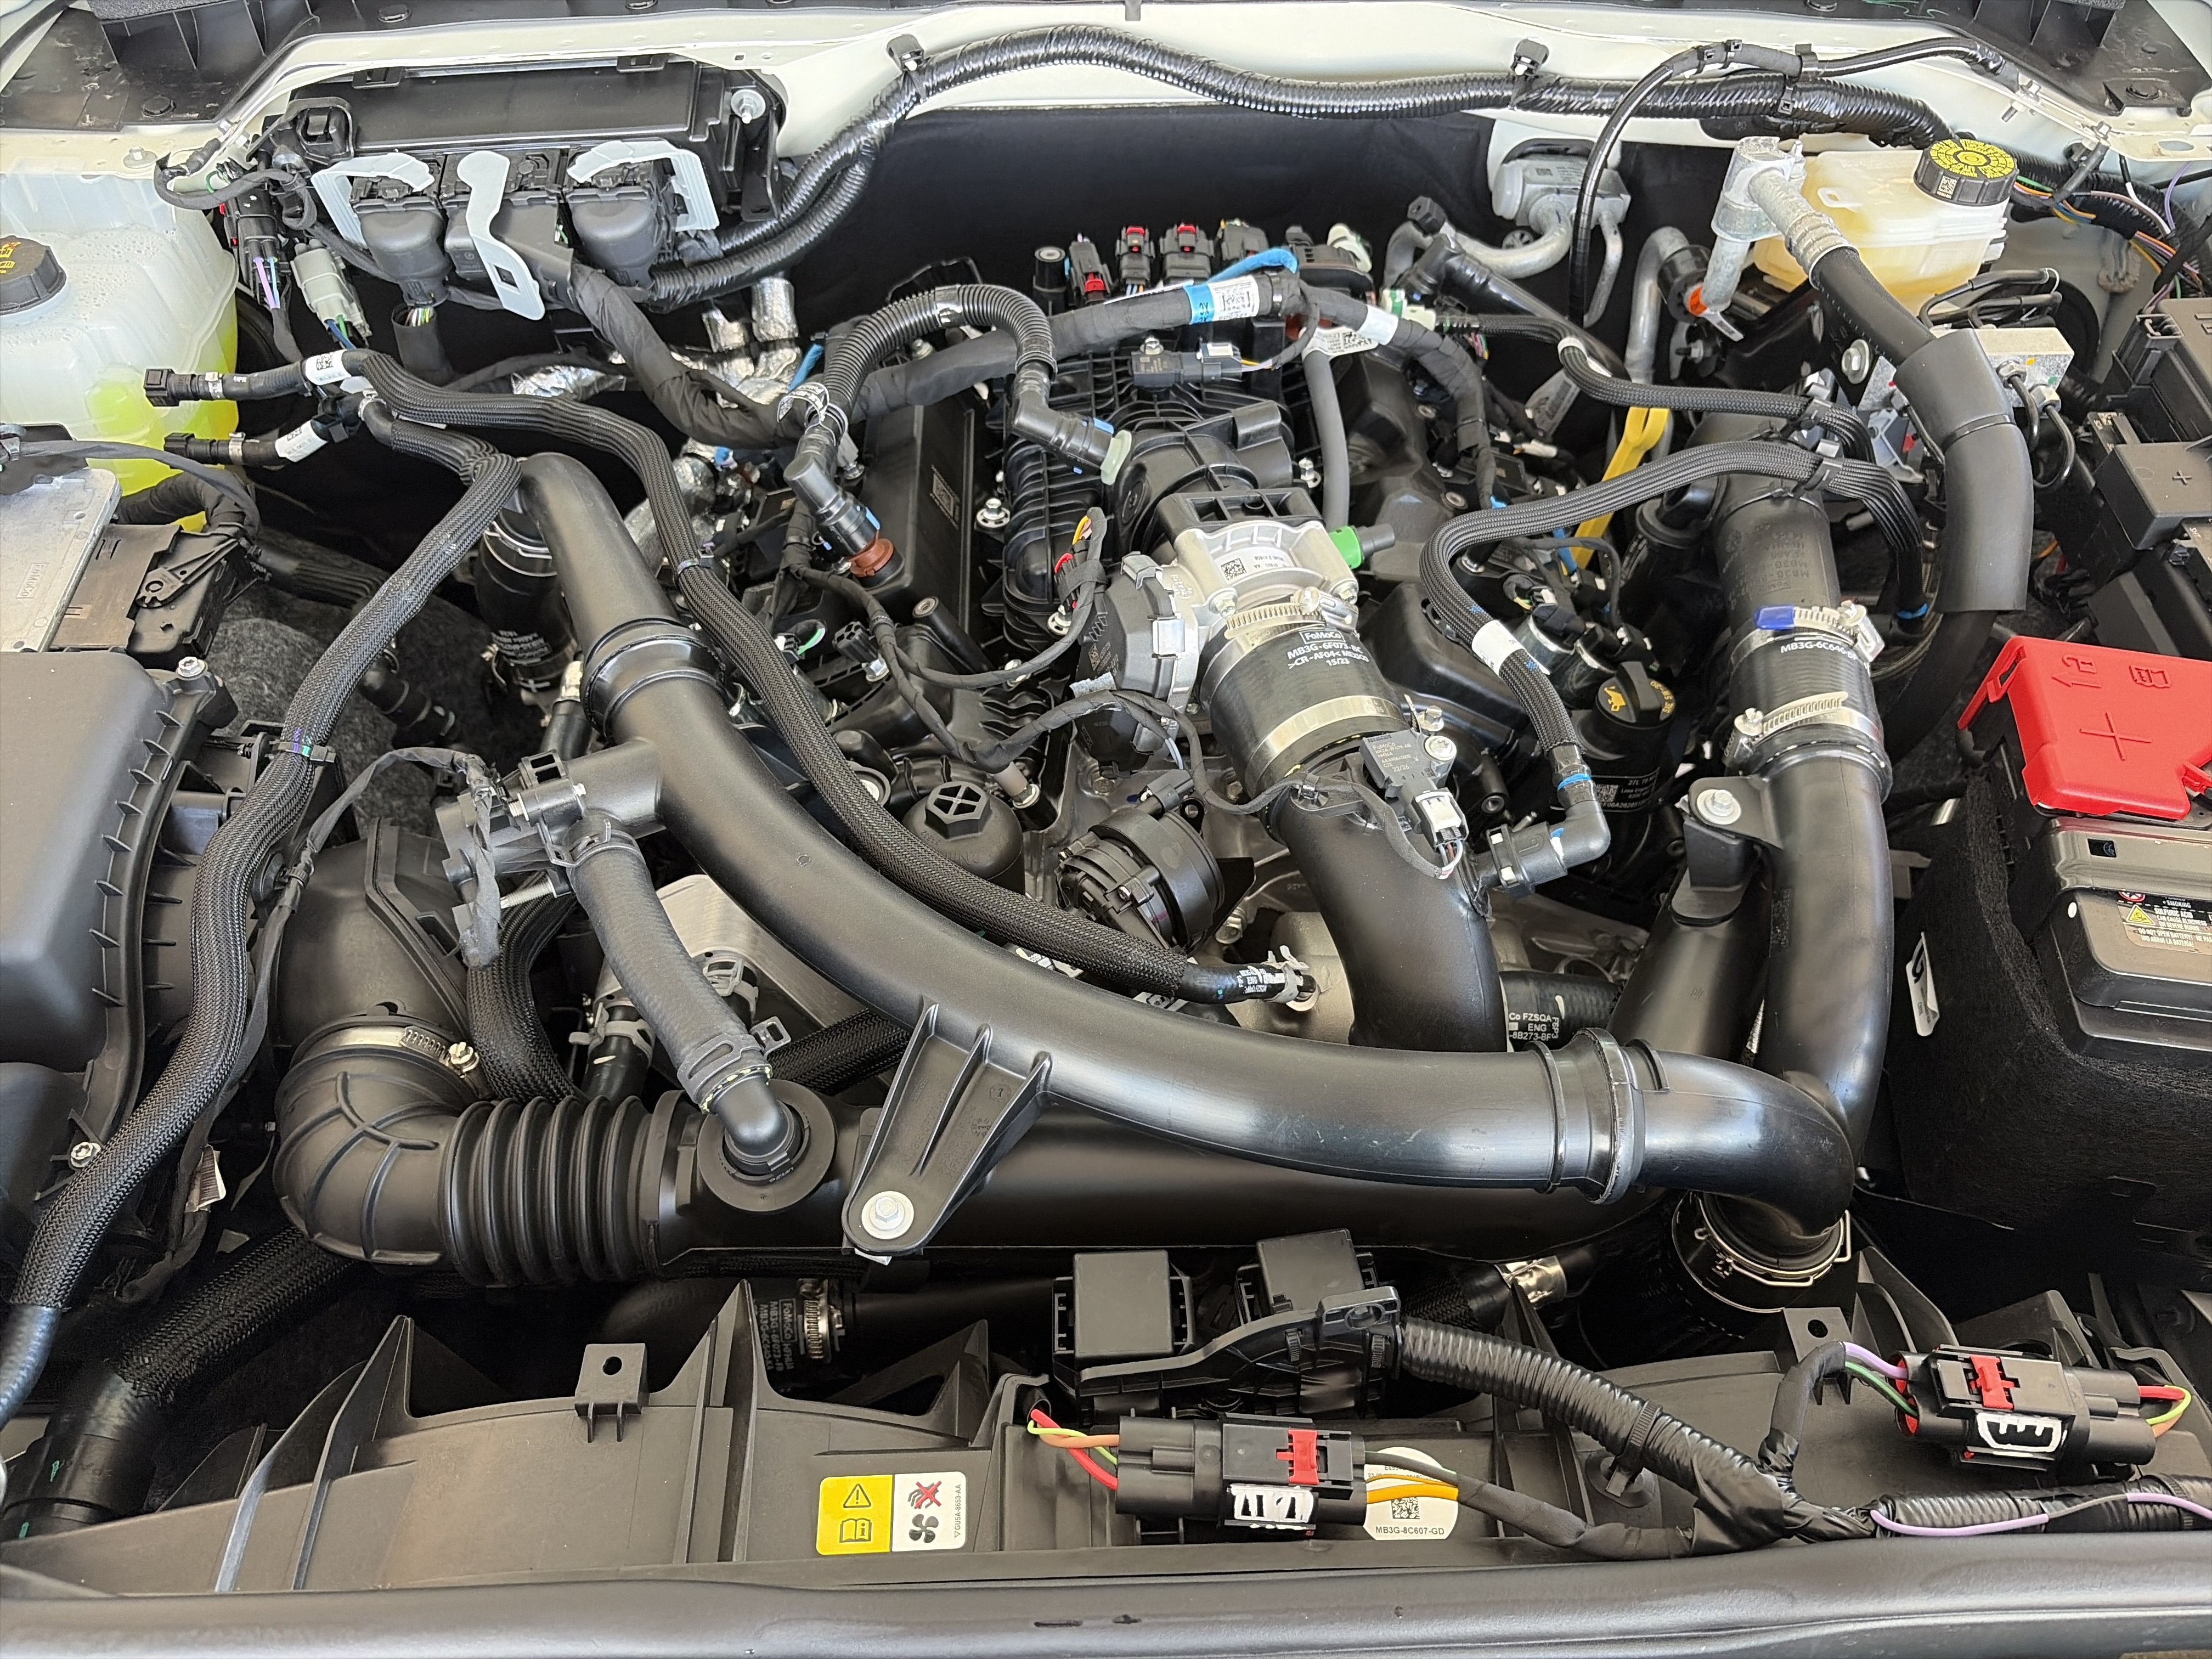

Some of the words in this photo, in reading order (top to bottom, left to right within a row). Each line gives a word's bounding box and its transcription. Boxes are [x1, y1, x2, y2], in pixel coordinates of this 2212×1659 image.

[22, 565, 44, 597] FoMoCo
[1304, 631, 1342, 640] FoMoCo
[1287, 642, 1363, 659] MB3G-6F073-BC
[1325, 658, 1350, 666] 15/23
[1373, 742, 1396, 751] FoMoCo
[2166, 900, 2192, 909] SMOKING
[2154, 907, 2180, 917] SULFURIC
[2180, 911, 2193, 919] ACID
[2182, 918, 2208, 927] BLINDNESS
[2170, 931, 2192, 940] BATTERY!
[1527, 1023, 1547, 1032] ENG
[783, 1302, 793, 1339] FoMoCo
[1375, 1526, 1444, 1535] MB3G-8C607-GD
